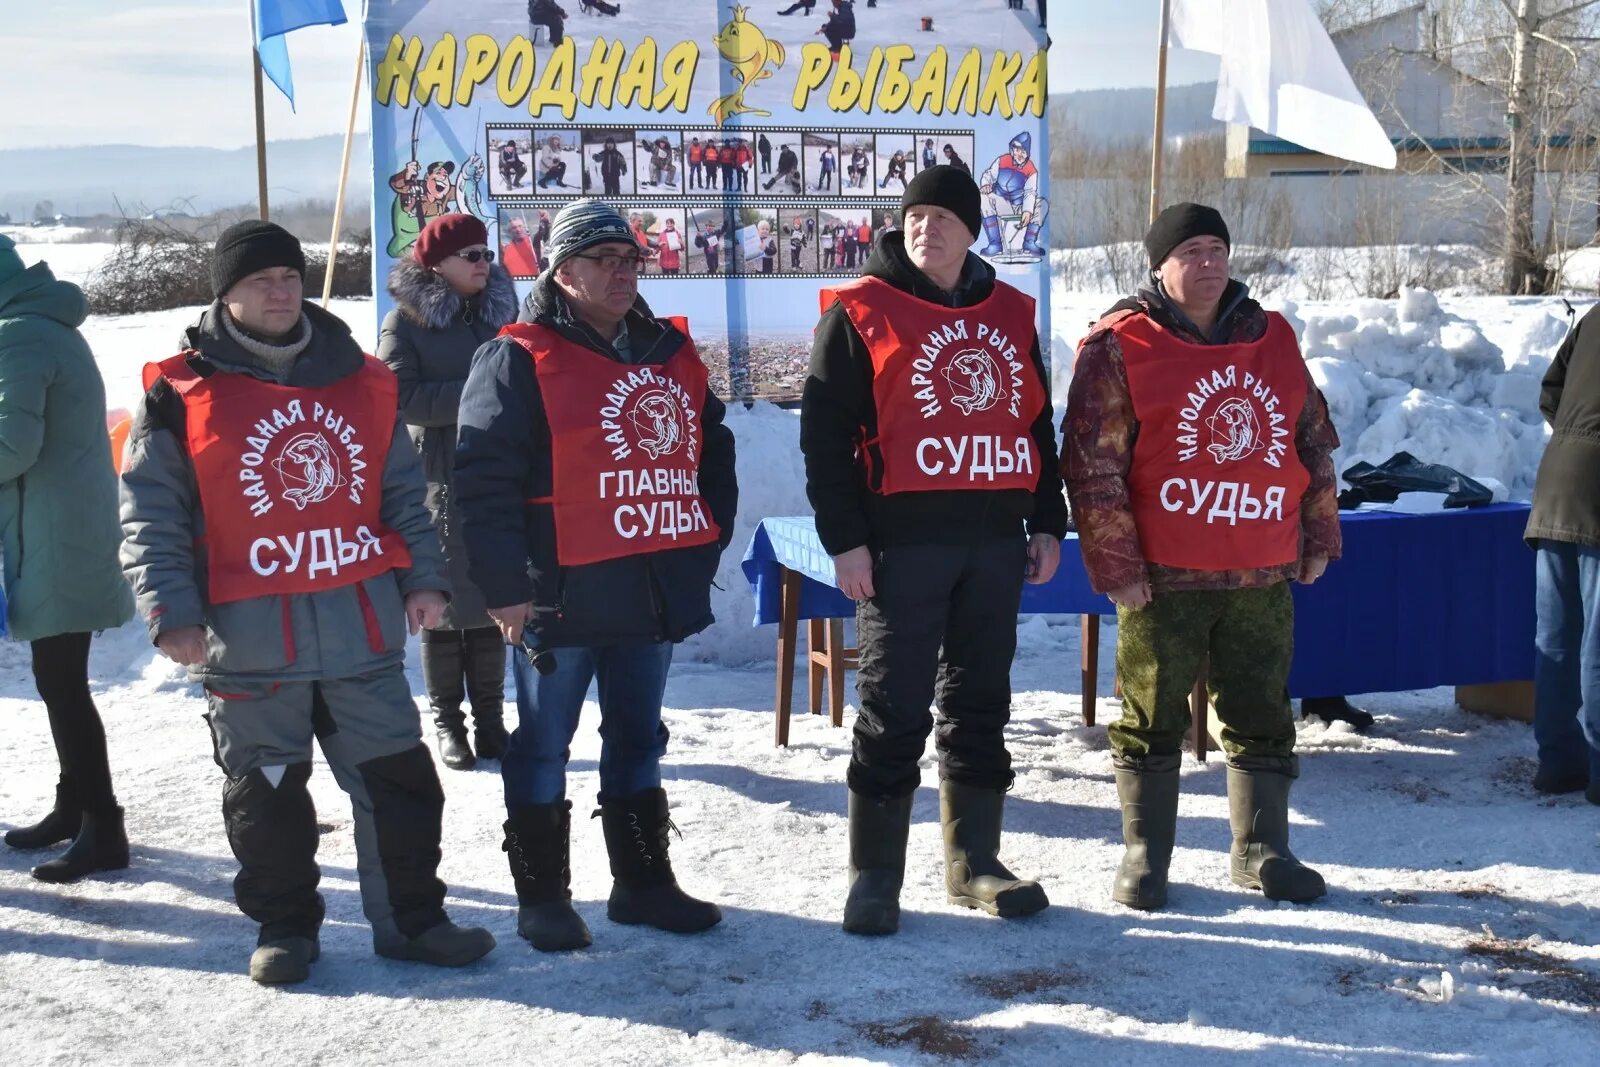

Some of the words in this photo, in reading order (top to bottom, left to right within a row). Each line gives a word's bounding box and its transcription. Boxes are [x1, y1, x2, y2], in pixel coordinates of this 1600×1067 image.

[375, 32, 700, 121] НАРОДНАЯ
[791, 42, 1047, 120] РЫБАЛКА
[911, 319, 968, 419] НАРОДНАЯ
[976, 322, 1024, 418] РЫБАЛКА
[239, 399, 305, 517] НАРОДНАЯ
[314, 401, 367, 505] РЫБАЛКА
[600, 367, 656, 461] НАРОДНАЯ
[656, 375, 697, 462] РЫБАЛКА
[915, 435, 1033, 481] СУДЬЯ
[1175, 365, 1236, 462] НАРОДНАЯ
[1243, 372, 1289, 468] РЫБАЛКА
[613, 499, 709, 541] СУДЬЯ
[1159, 477, 1286, 525] СУДЬЯ
[250, 525, 384, 579] СУДЬЯ
